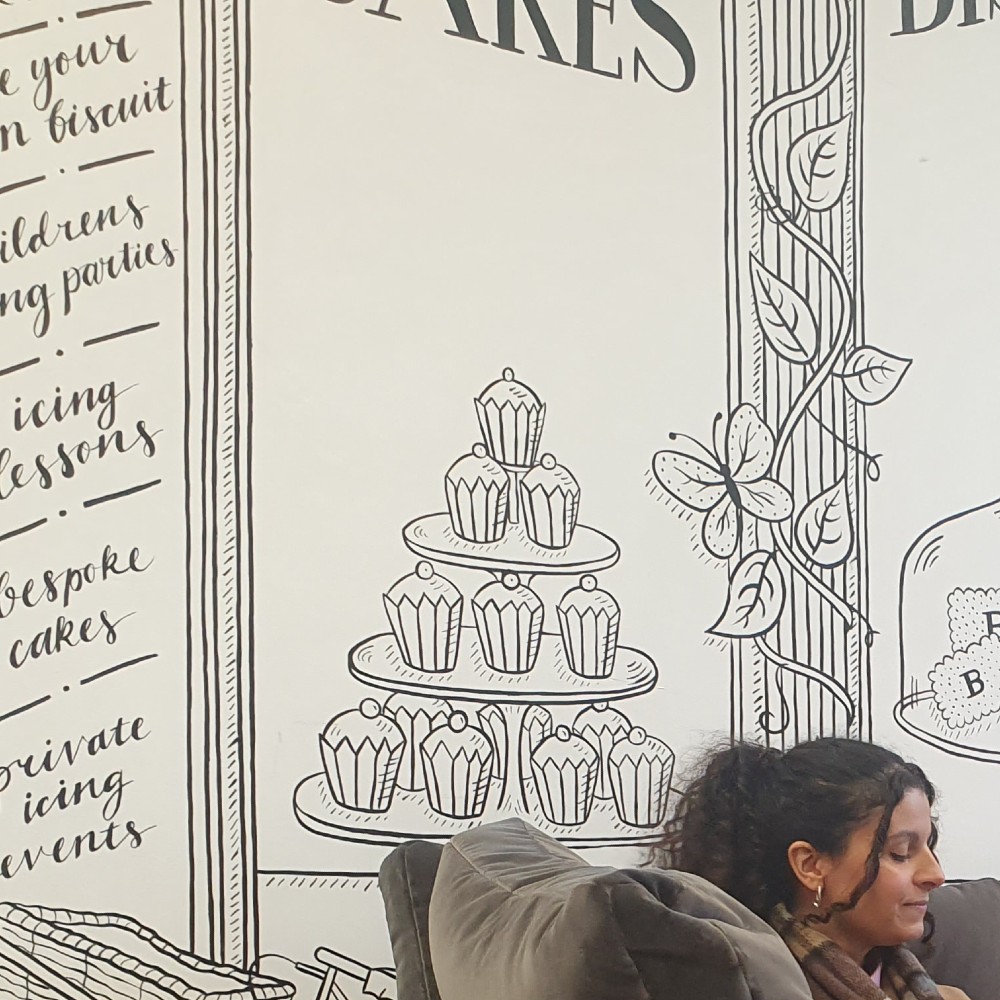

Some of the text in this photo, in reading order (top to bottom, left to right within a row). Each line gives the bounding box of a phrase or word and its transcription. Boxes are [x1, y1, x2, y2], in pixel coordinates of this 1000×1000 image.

[30, 33, 139, 112] your
[326, 0, 697, 93] KES
[44, 76, 174, 144] biscuit
[62, 238, 179, 317] parties
[14, 381, 140, 432] icing
[0, 544, 155, 619] bespoke
[9, 610, 137, 669] cakes
[959, 668, 985, 699] B
[24, 769, 134, 822] icing
[0, 820, 157, 879] events
